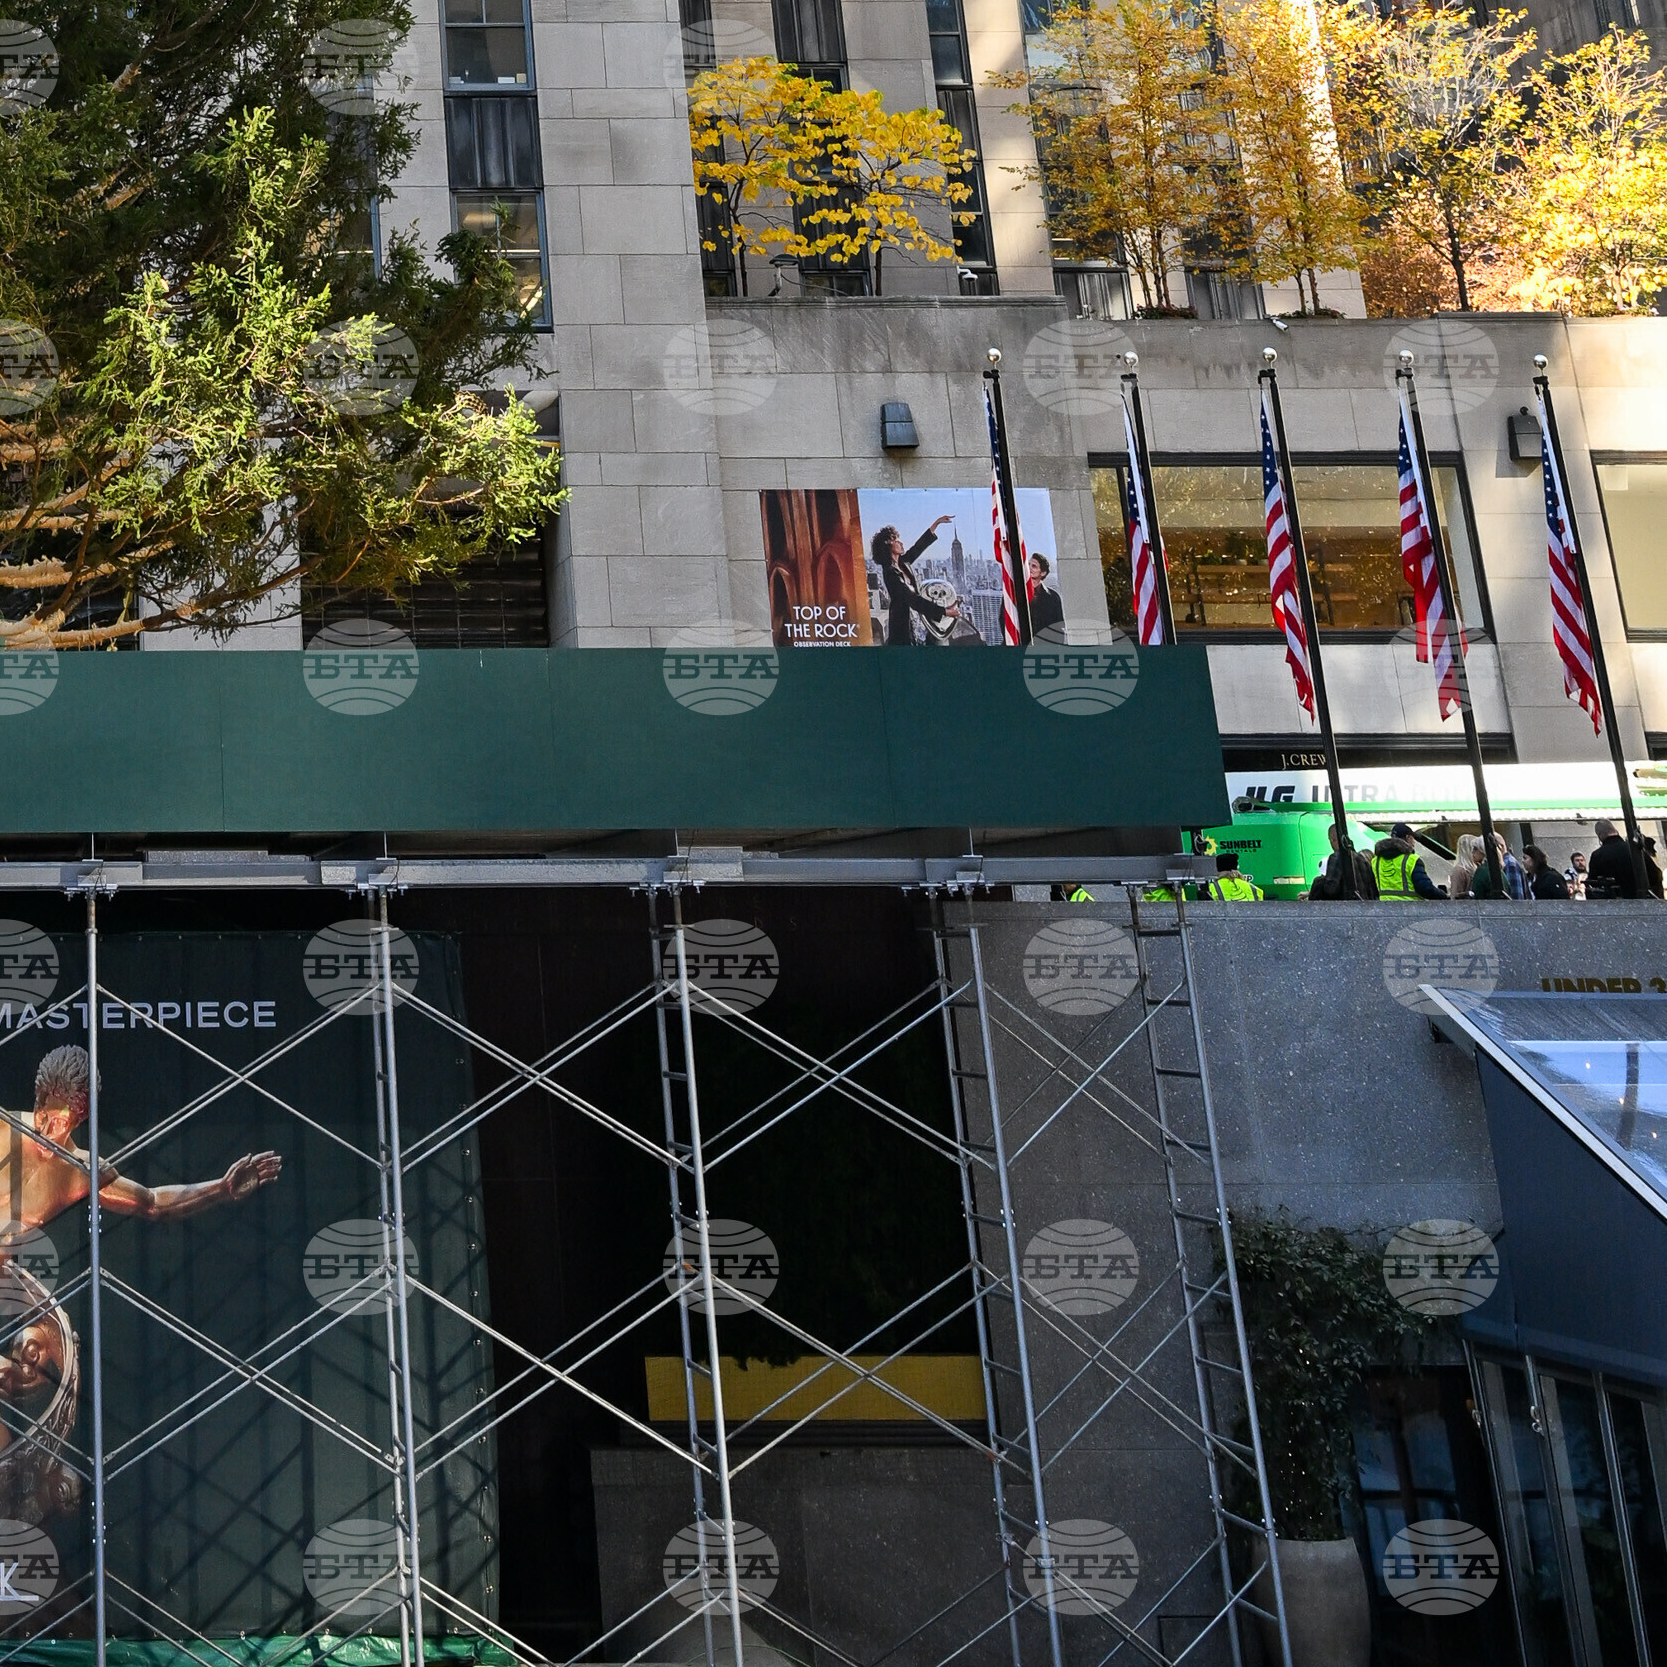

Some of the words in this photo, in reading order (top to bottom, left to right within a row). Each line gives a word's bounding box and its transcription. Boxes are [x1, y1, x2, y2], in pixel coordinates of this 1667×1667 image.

[792, 605, 822, 621] TOP
[826, 605, 846, 621] OF
[784, 623, 811, 638] THE
[793, 640, 834, 648] OBSERVATION
[835, 640, 851, 648] DECK
[1312, 784, 1398, 802] UTRA
[1219, 839, 1263, 850] SUNBELT
